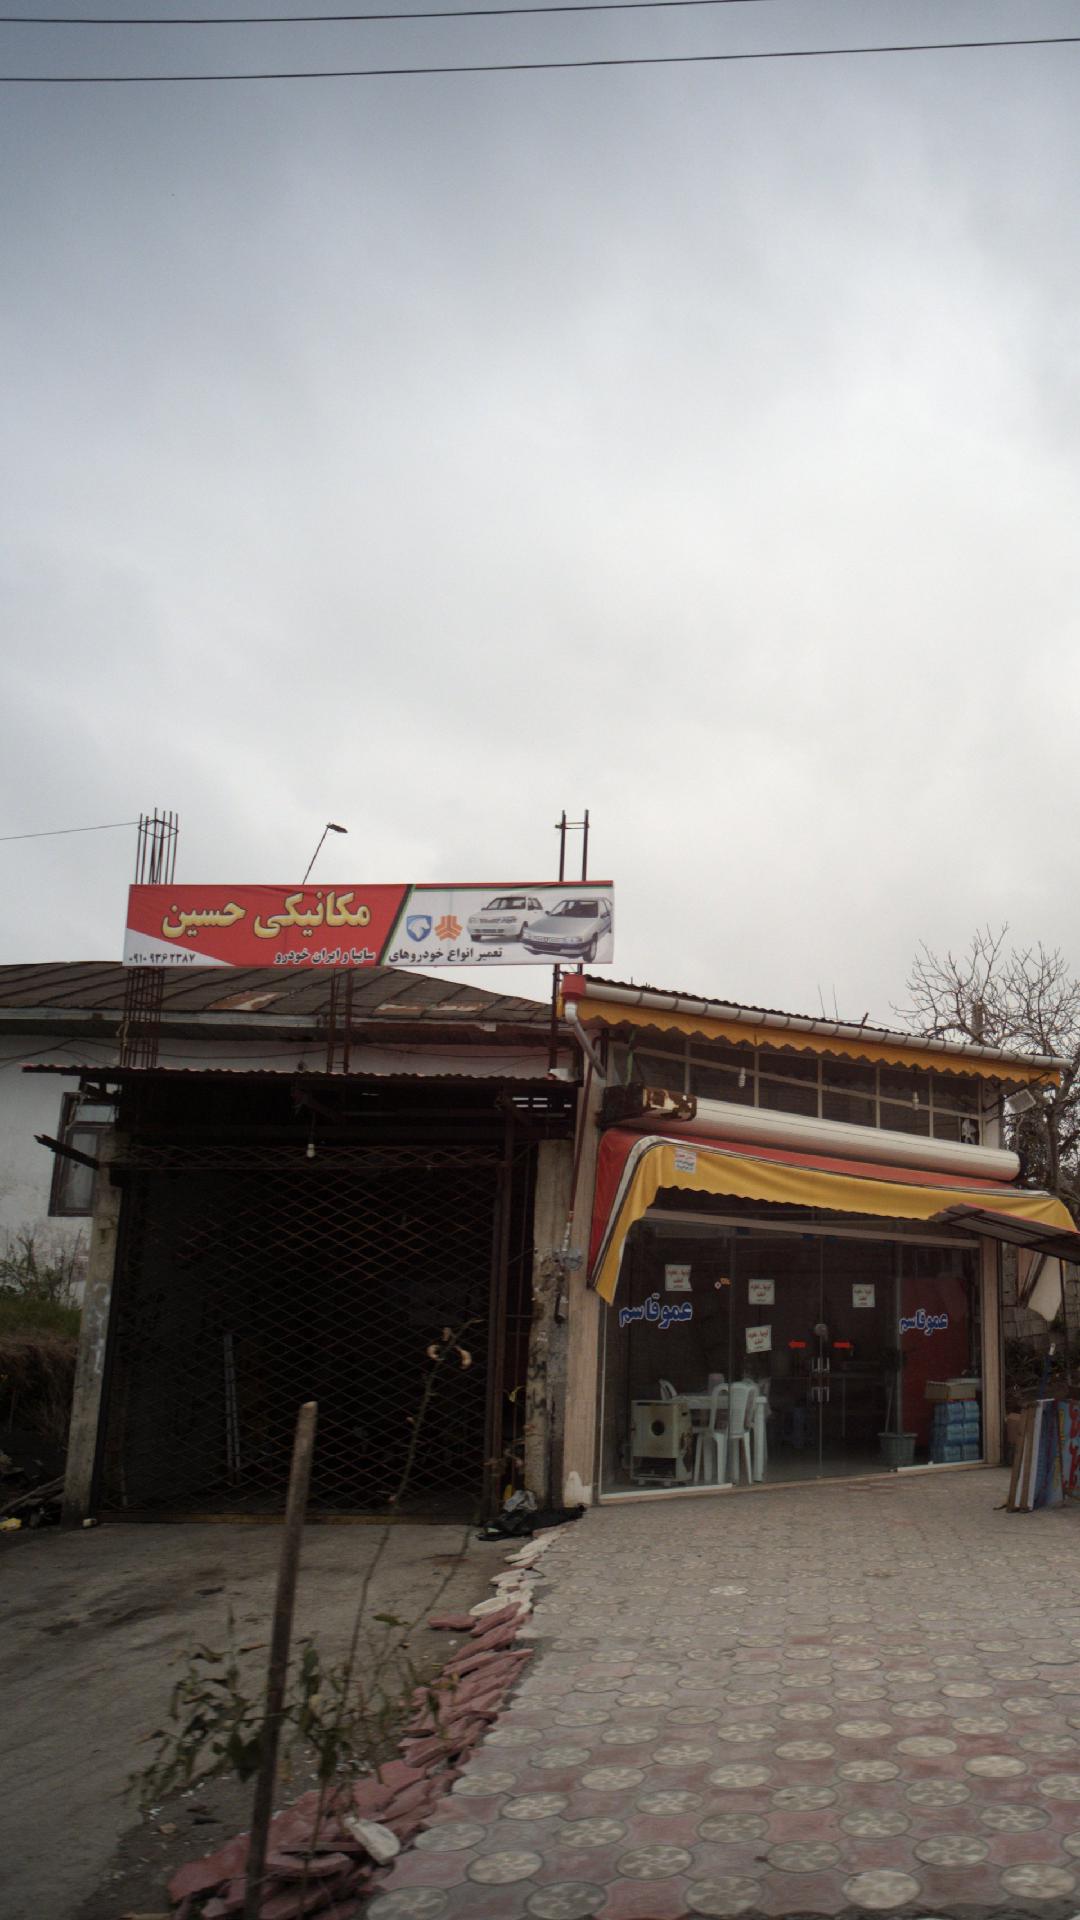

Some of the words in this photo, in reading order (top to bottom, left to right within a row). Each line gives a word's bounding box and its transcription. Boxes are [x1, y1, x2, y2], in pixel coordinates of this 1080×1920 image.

[161, 901, 247, 939] حسین
[253, 891, 370, 938] مکانیکی
[273, 948, 310, 965] خودرو
[312, 946, 341, 965] ایران
[340, 953, 349, 965] و
[351, 947, 376, 964] سایپا
[447, 947, 474, 962] انواع
[476, 947, 503, 961] تعمیر
